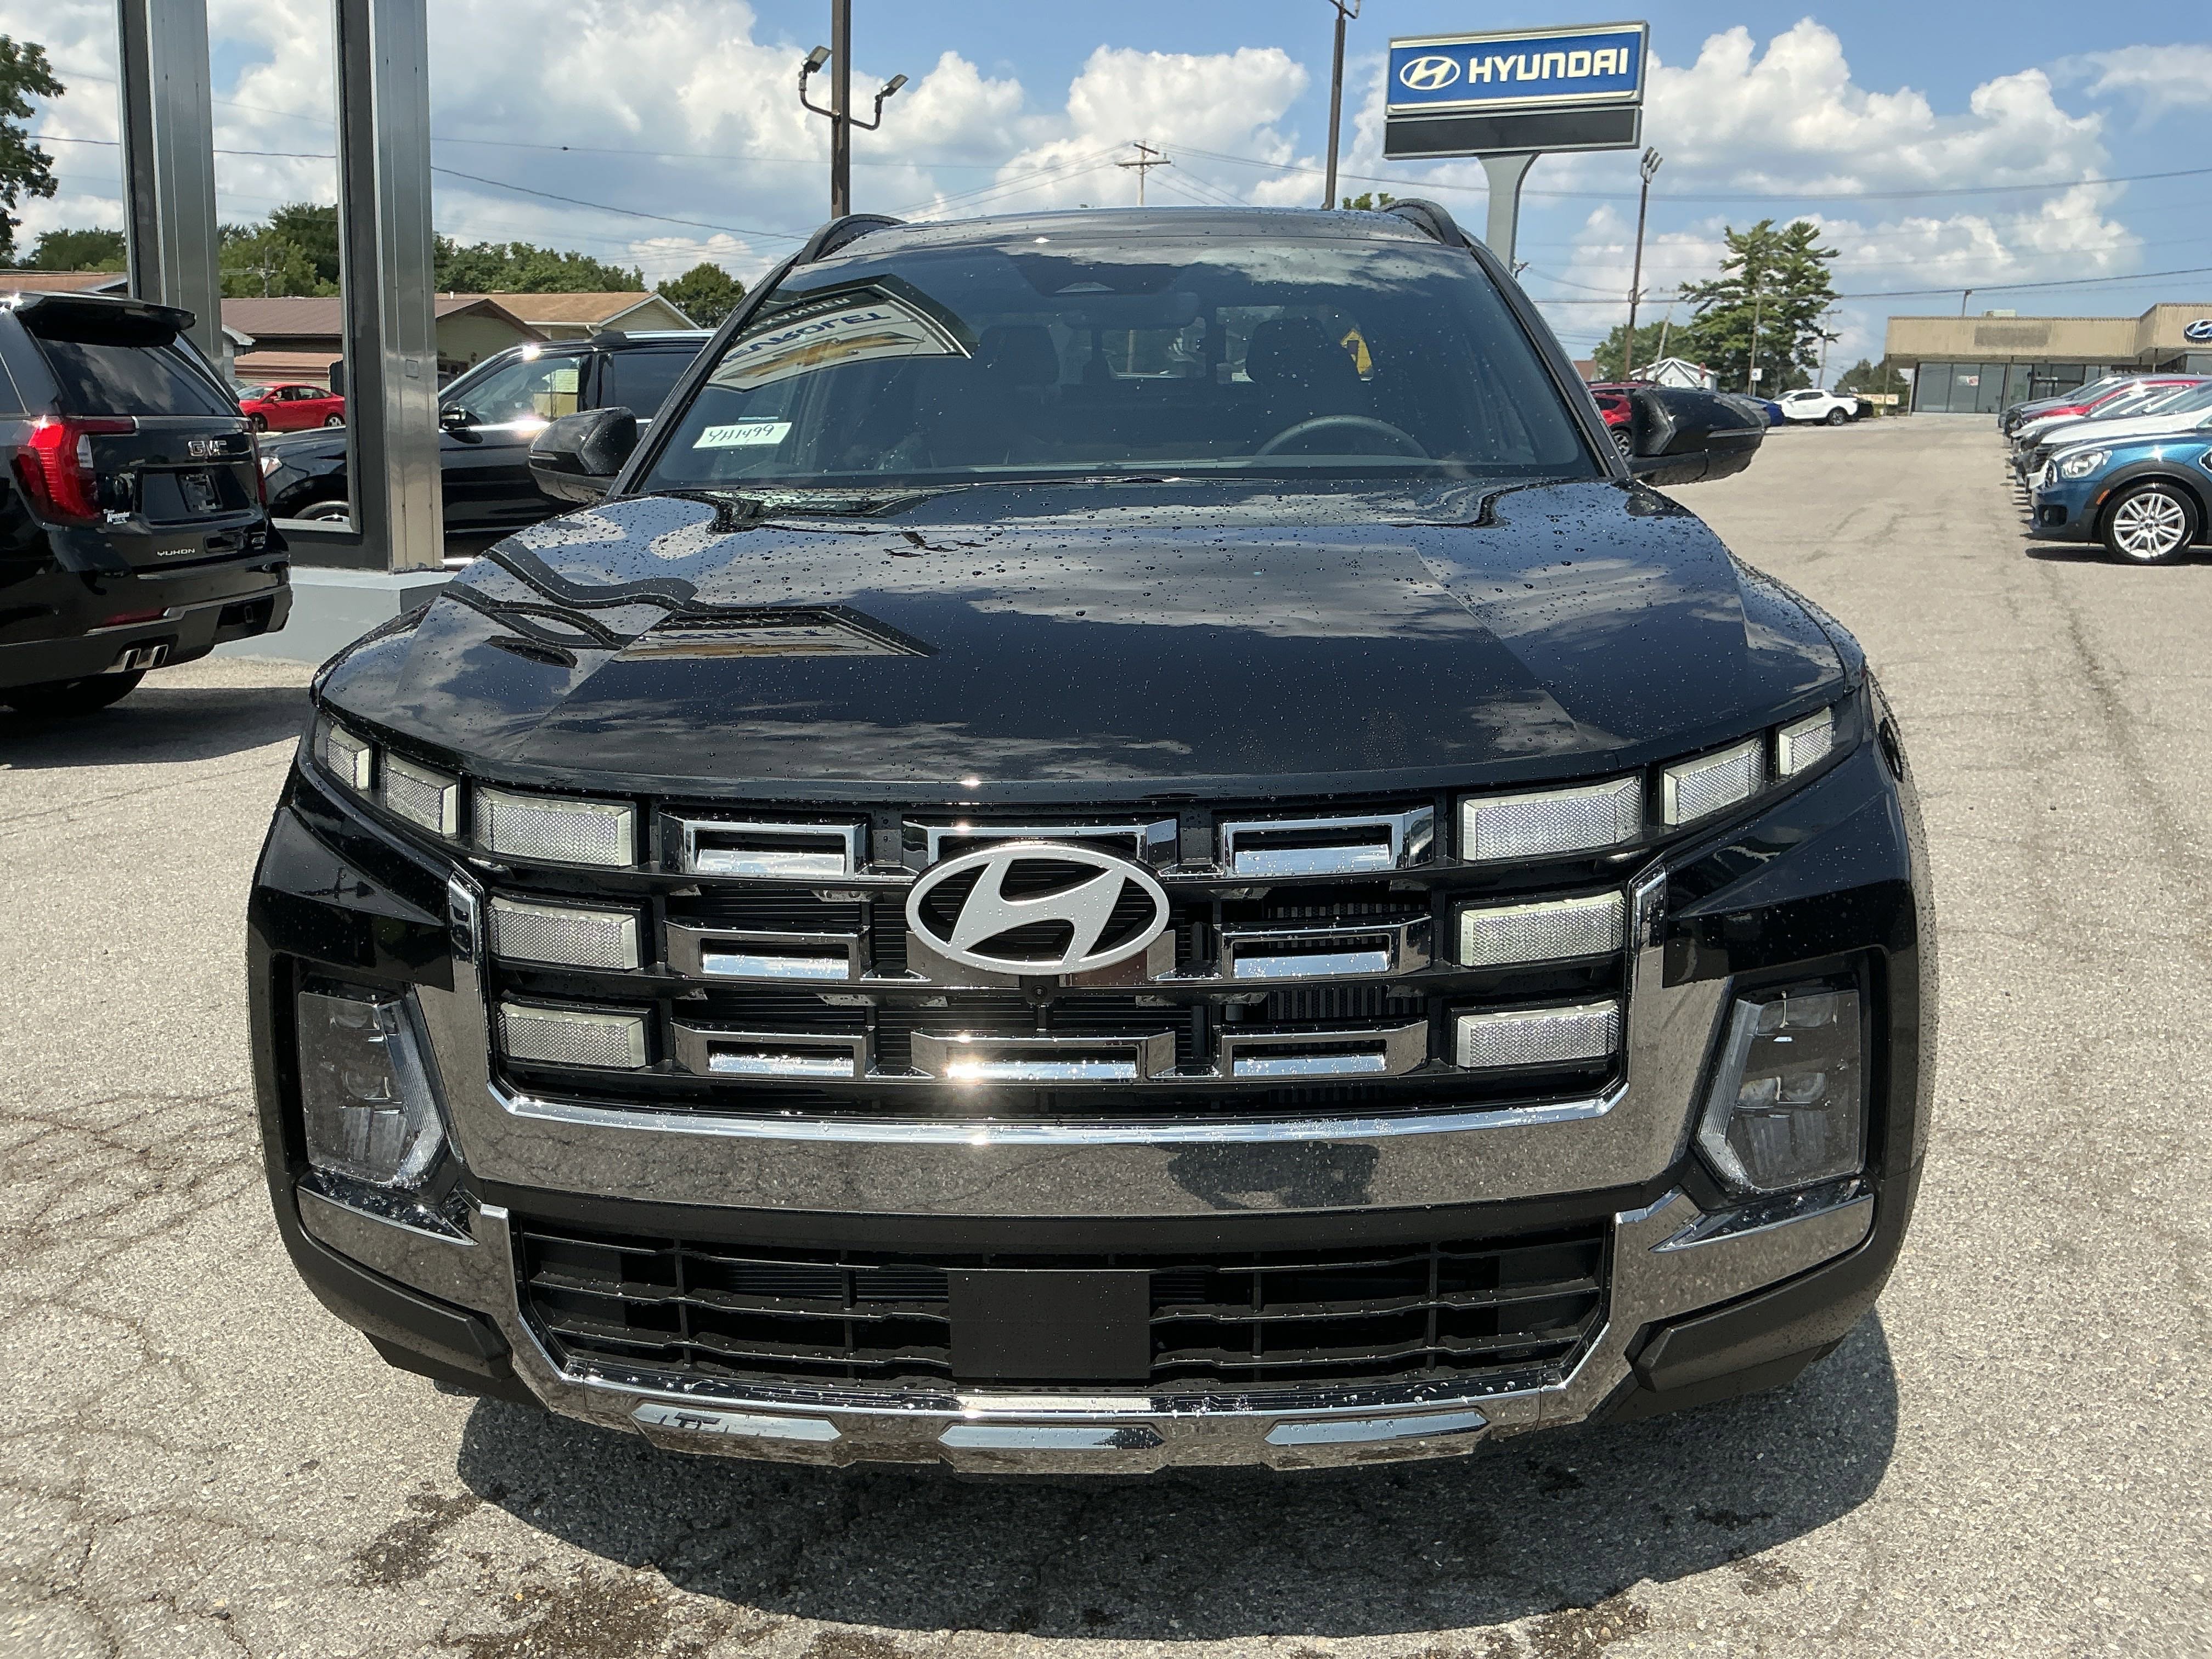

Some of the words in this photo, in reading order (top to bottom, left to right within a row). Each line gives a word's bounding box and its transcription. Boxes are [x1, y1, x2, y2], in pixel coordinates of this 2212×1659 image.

[1469, 48, 1628, 83] HYUNDAI
[709, 424, 775, 443] YH1499
[188, 440, 228, 456] GMC
